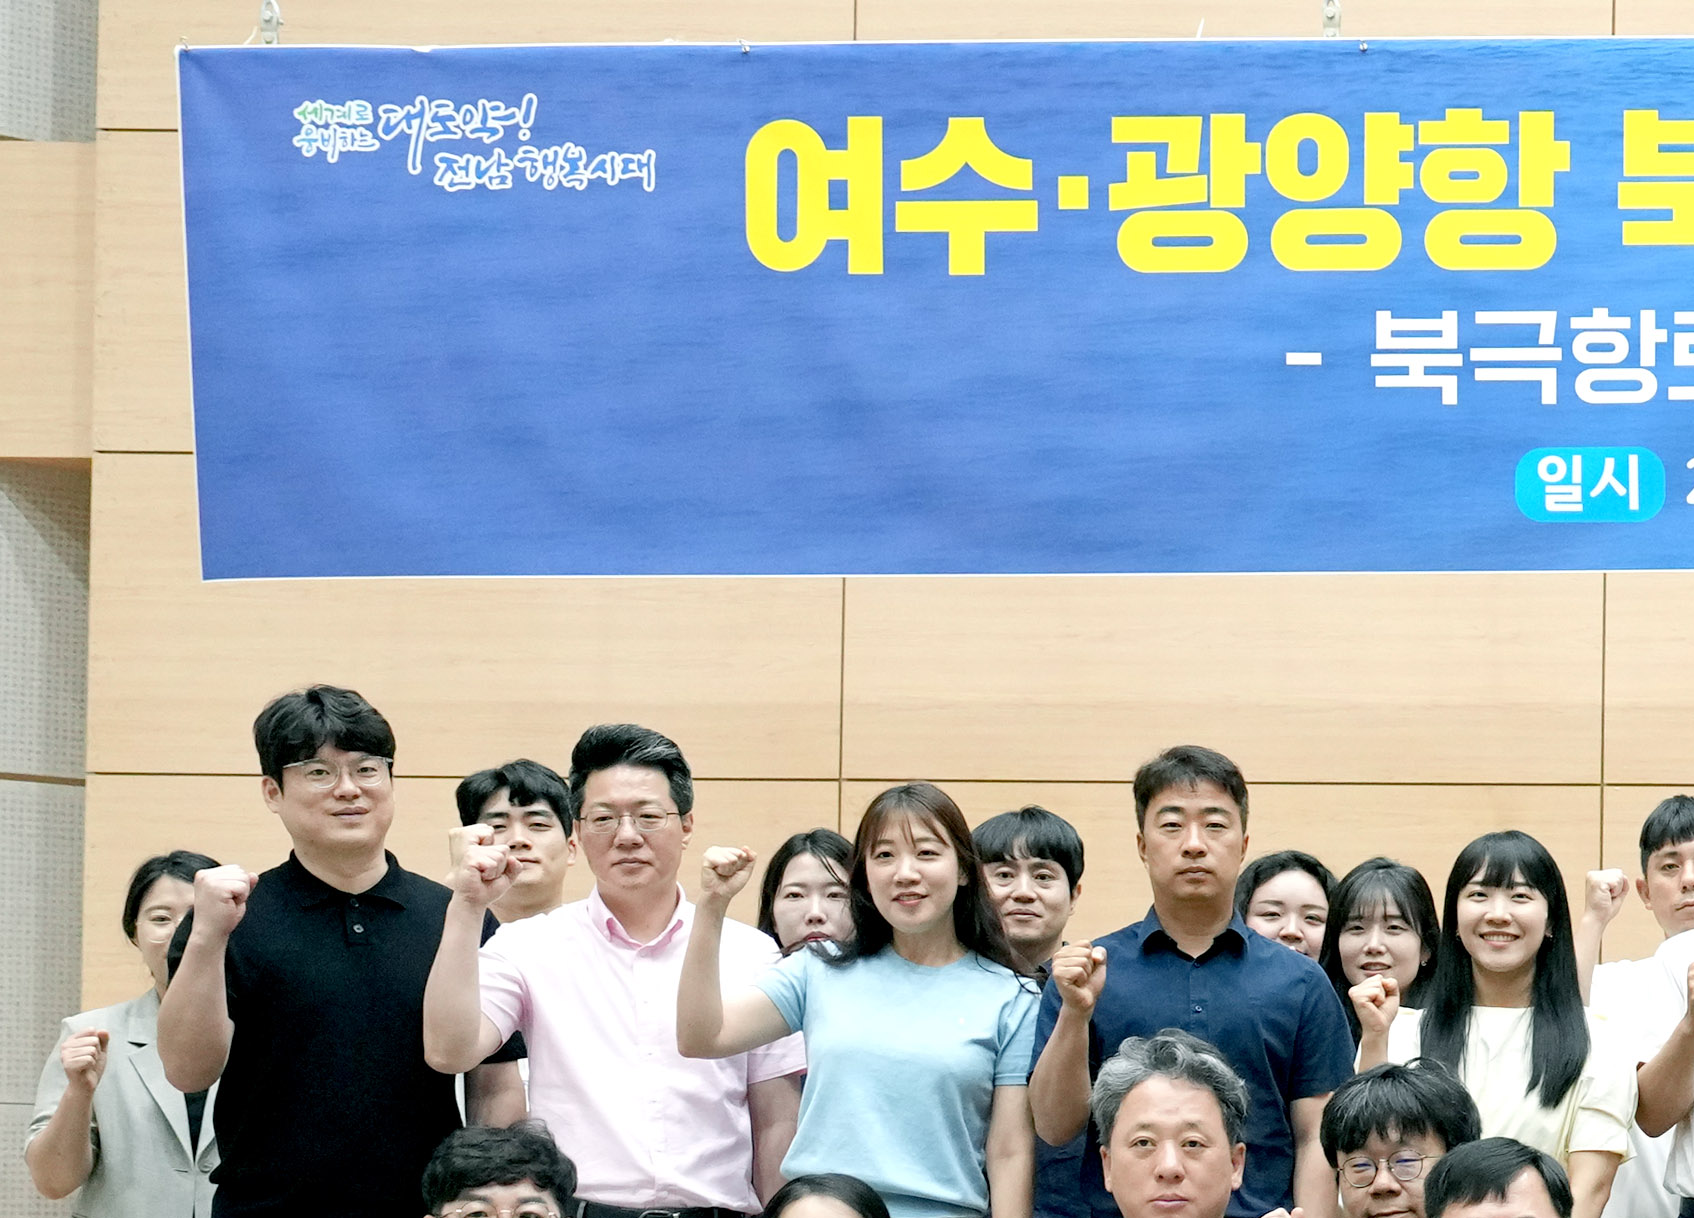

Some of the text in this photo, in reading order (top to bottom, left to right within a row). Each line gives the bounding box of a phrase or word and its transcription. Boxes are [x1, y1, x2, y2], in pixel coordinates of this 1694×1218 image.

[433, 147, 514, 192] 전남
[747, 109, 1570, 275] 여수·광양항
[1536, 455, 1640, 512] 일시
